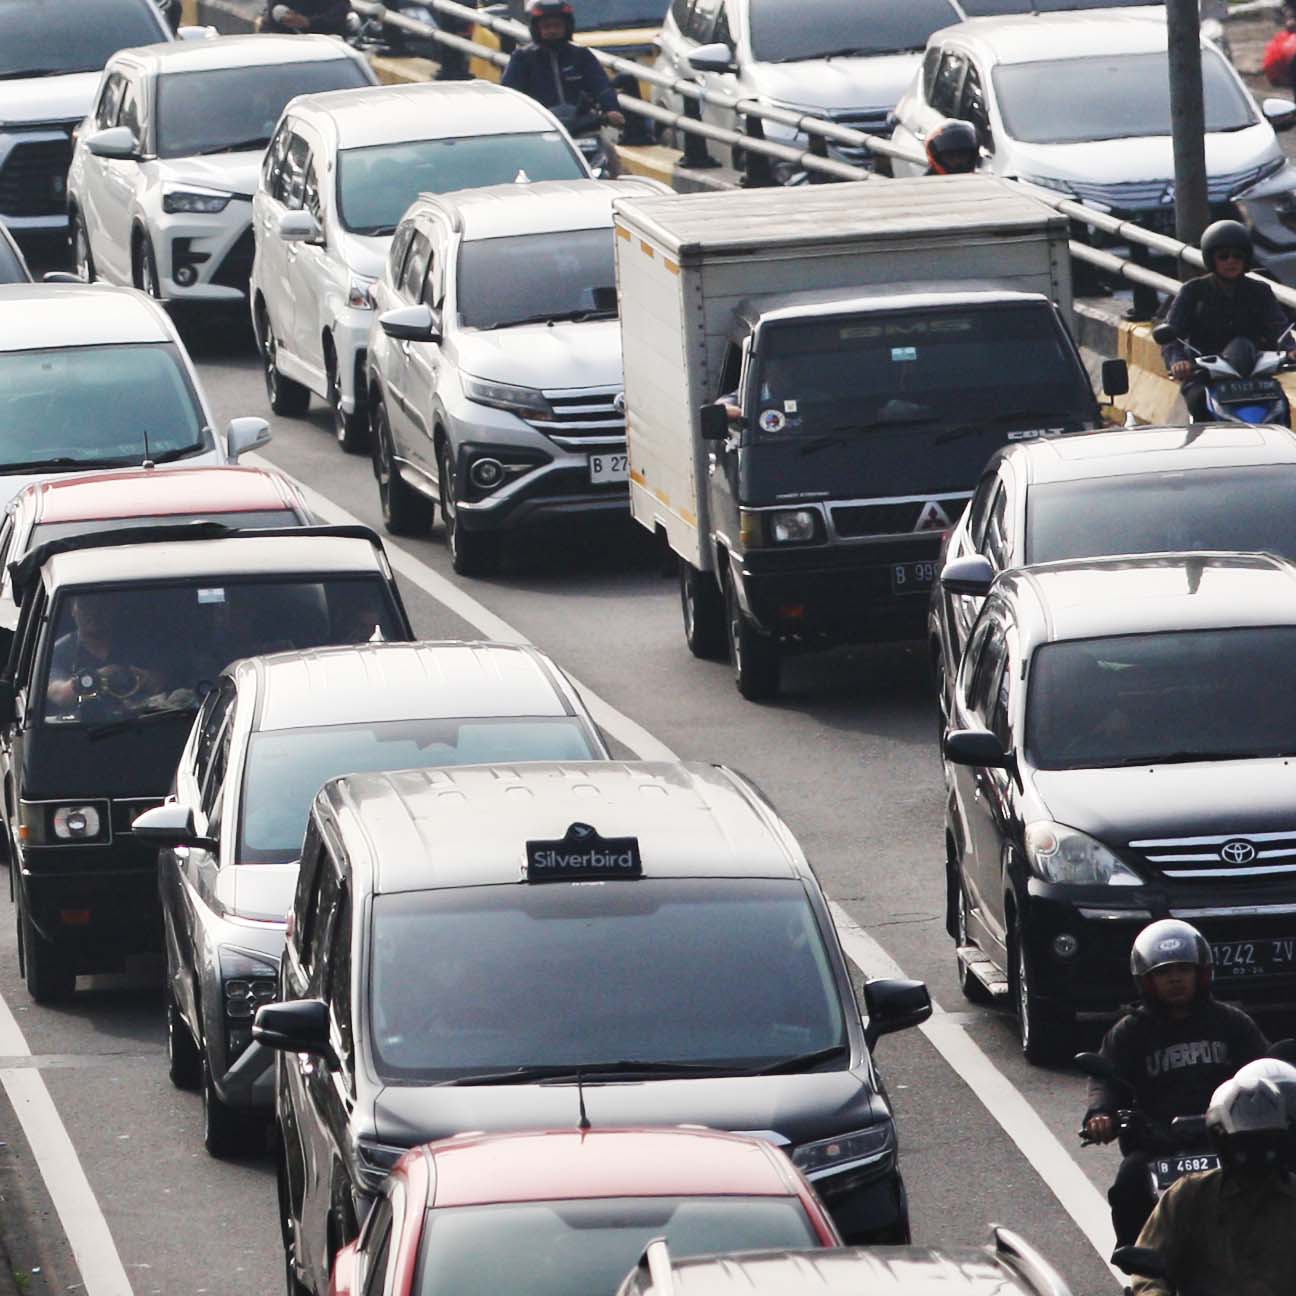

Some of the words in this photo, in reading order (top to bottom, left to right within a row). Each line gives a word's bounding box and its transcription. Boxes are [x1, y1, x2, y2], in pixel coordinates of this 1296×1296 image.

[593, 457, 602, 473] B
[896, 566, 906, 584] B
[534, 850, 633, 868] Silverbird
[1161, 1163, 1169, 1173] B
[1177, 1158, 1209, 1172] 4682
